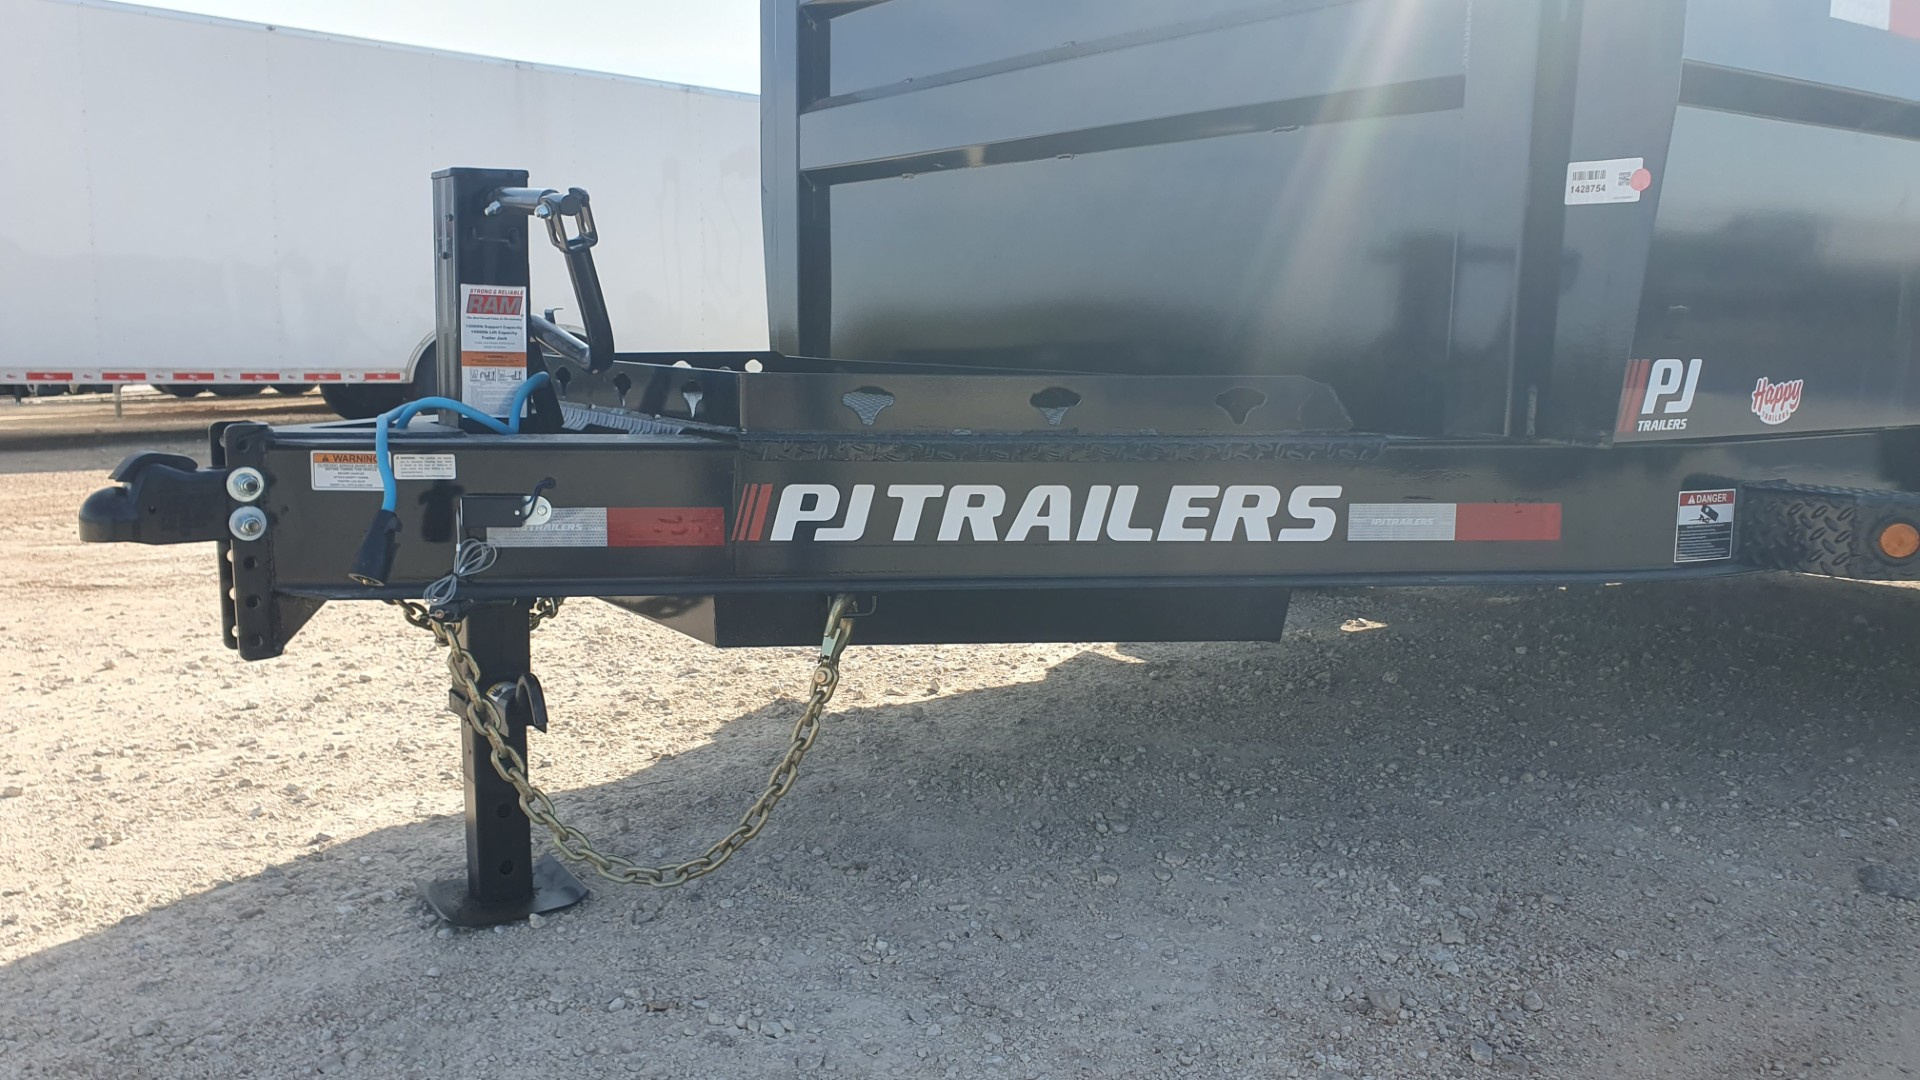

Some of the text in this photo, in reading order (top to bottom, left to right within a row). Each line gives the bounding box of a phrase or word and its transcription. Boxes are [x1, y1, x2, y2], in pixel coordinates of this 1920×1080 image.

[1570, 184, 1606, 194] 1428754
[467, 296, 522, 315] RAM
[1641, 359, 1703, 414] PJ
[1753, 377, 1803, 412] Happy
[1761, 410, 1790, 422] TRAILERS
[1637, 418, 1688, 432] TRAILERS
[1696, 493, 1728, 504] DANGER
[770, 484, 1342, 541] PJ TRAILERS
